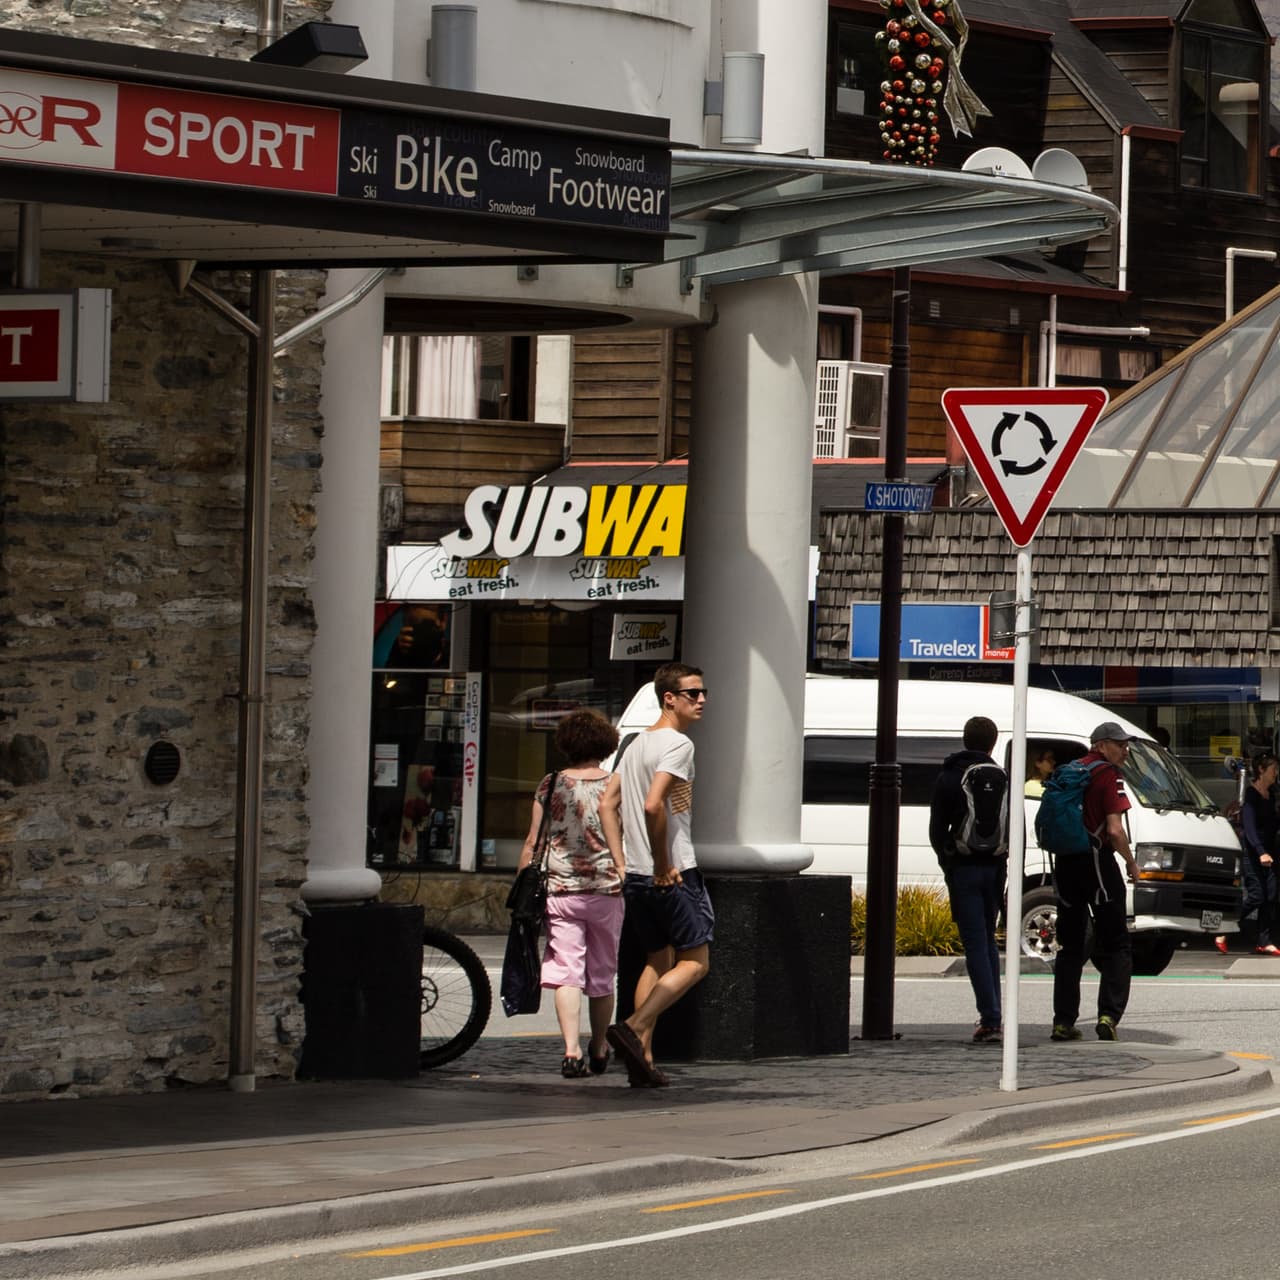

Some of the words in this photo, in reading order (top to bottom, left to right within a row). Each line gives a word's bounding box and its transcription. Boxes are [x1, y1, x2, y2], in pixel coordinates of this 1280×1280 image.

[143, 107, 315, 171] SPORT
[350, 145, 378, 175] Ski
[394, 133, 478, 199] Bike
[488, 138, 542, 177] Camp
[575, 146, 645, 173] Snowboard
[363, 184, 377, 199] Ski
[548, 167, 666, 216] Footwear
[488, 199, 536, 217] Snowboard
[440, 484, 688, 558] SUBWA
[432, 557, 510, 581] SUBWAY
[569, 557, 651, 581] SUBWAY
[449, 584, 473, 598] eat
[477, 575, 520, 593] fresh.
[587, 584, 611, 599] eat
[616, 575, 660, 593] fresh.
[617, 620, 665, 640] SUBWAY
[627, 642, 643, 655] eat
[909, 638, 977, 657] Travelex
[985, 649, 1010, 659] money
